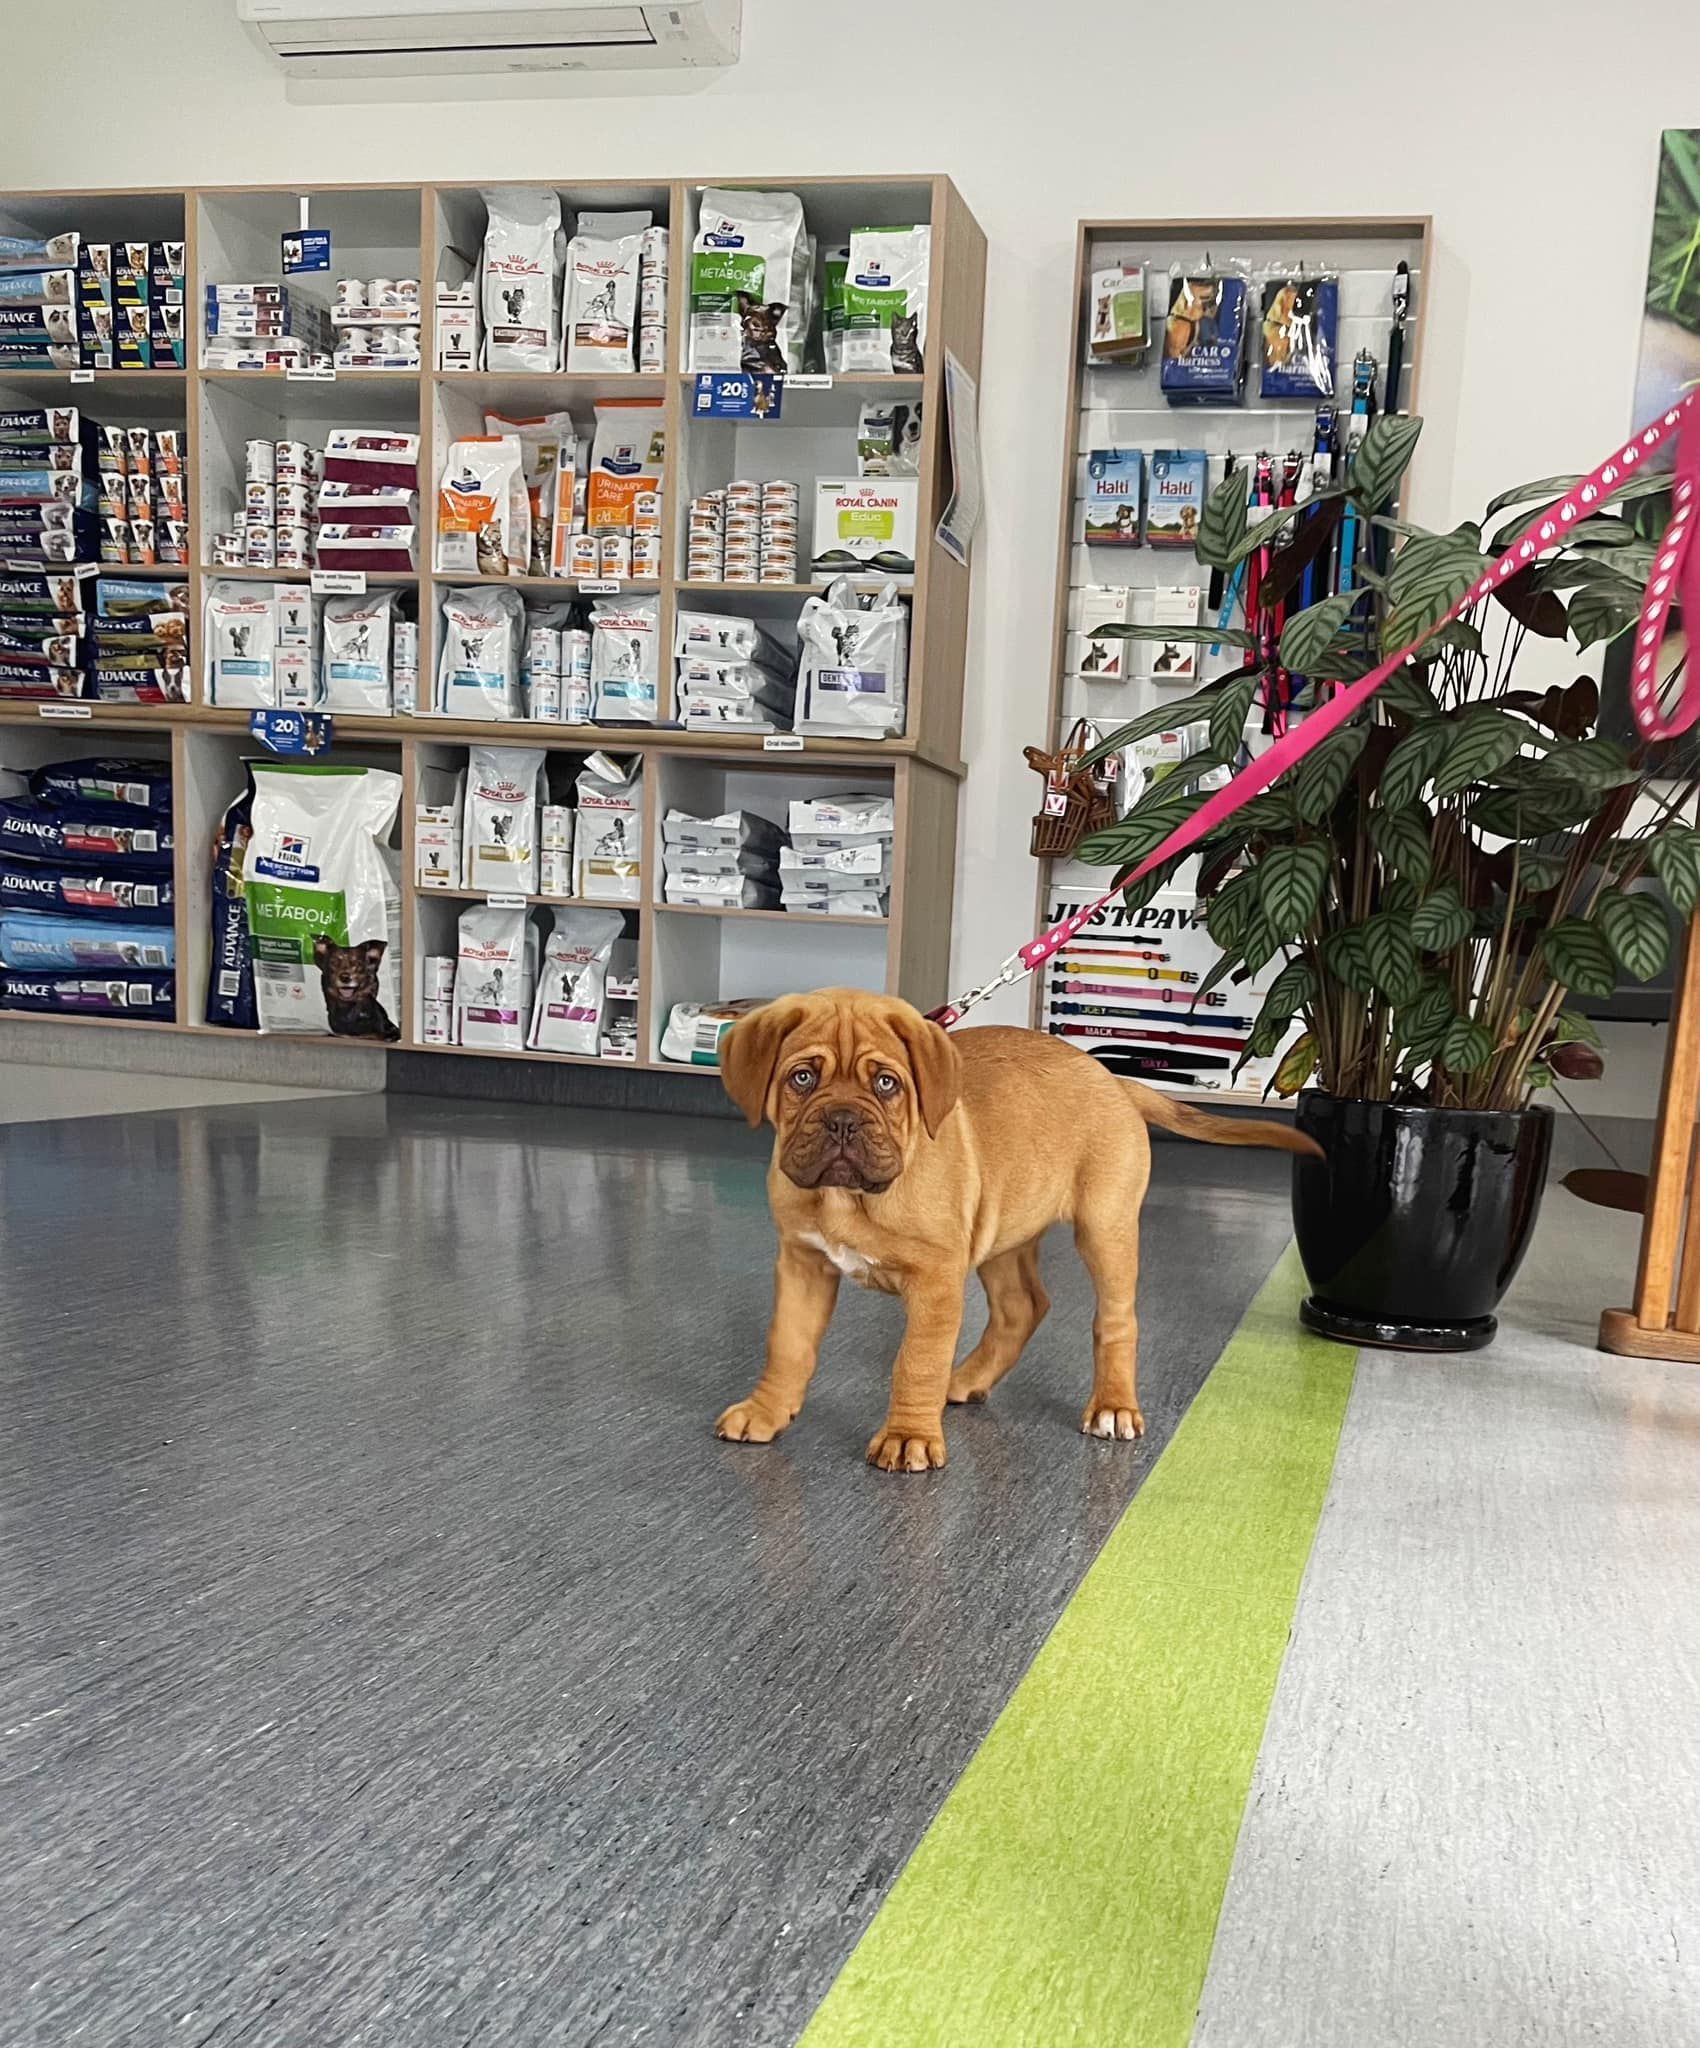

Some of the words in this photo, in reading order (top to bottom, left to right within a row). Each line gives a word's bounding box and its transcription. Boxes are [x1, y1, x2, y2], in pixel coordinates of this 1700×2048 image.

[700, 267, 757, 281] METABOL
[1102, 278, 1122, 289] Car
[1191, 346, 1218, 357] CAR
[0, 415, 41, 427] DVANCE
[597, 478, 643, 491] URINARY
[1097, 480, 1129, 494] Halti
[1160, 480, 1193, 495] Halti
[597, 489, 624, 501] CARE
[836, 498, 865, 508] ROYAL
[867, 498, 898, 508] CANIN
[851, 511, 881, 522] Educ
[98, 670, 148, 682] ADVANCE
[1135, 745, 1159, 758] Play
[605, 798, 631, 807] CANIN
[2, 817, 58, 839] ADVANCE
[2, 875, 57, 892] ADVANCE
[223, 905, 241, 967] ADVANCE
[1085, 1027, 1113, 1037] MACK
